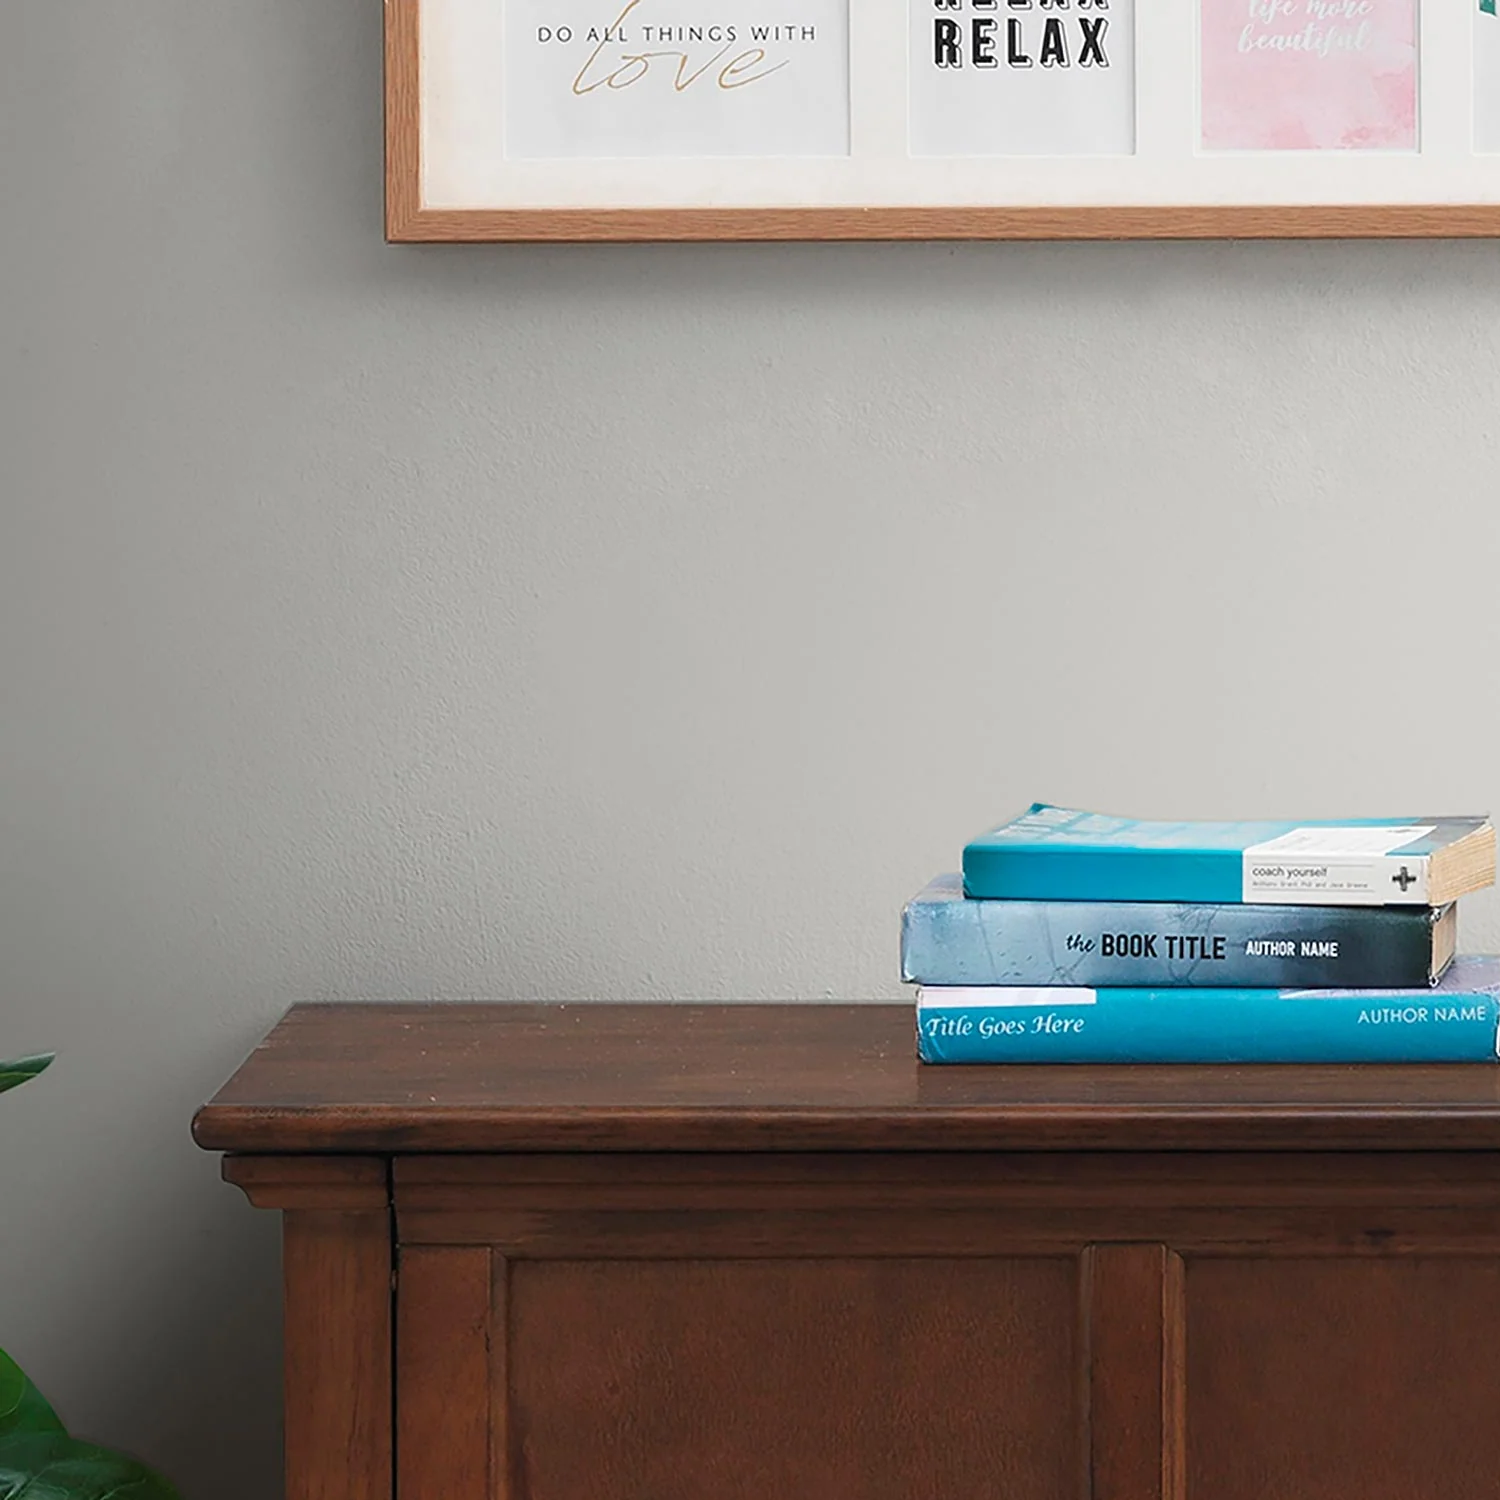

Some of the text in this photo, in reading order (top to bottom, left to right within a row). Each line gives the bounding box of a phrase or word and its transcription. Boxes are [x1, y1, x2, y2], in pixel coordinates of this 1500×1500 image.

[537, 25, 817, 43] DO ALL THINGS WITH
[935, 18, 1110, 69] RELAX
[1238, 21, 1372, 58] beautiful
[572, 0, 790, 95] love
[1252, 867, 1328, 879] coach yourself
[1066, 934, 1227, 960] the BOOK TITLE
[1246, 940, 1339, 958] AUTHOR NAME
[925, 1013, 1085, 1040] Title Goes Here
[1357, 1005, 1486, 1025] AUTHOR NAME
